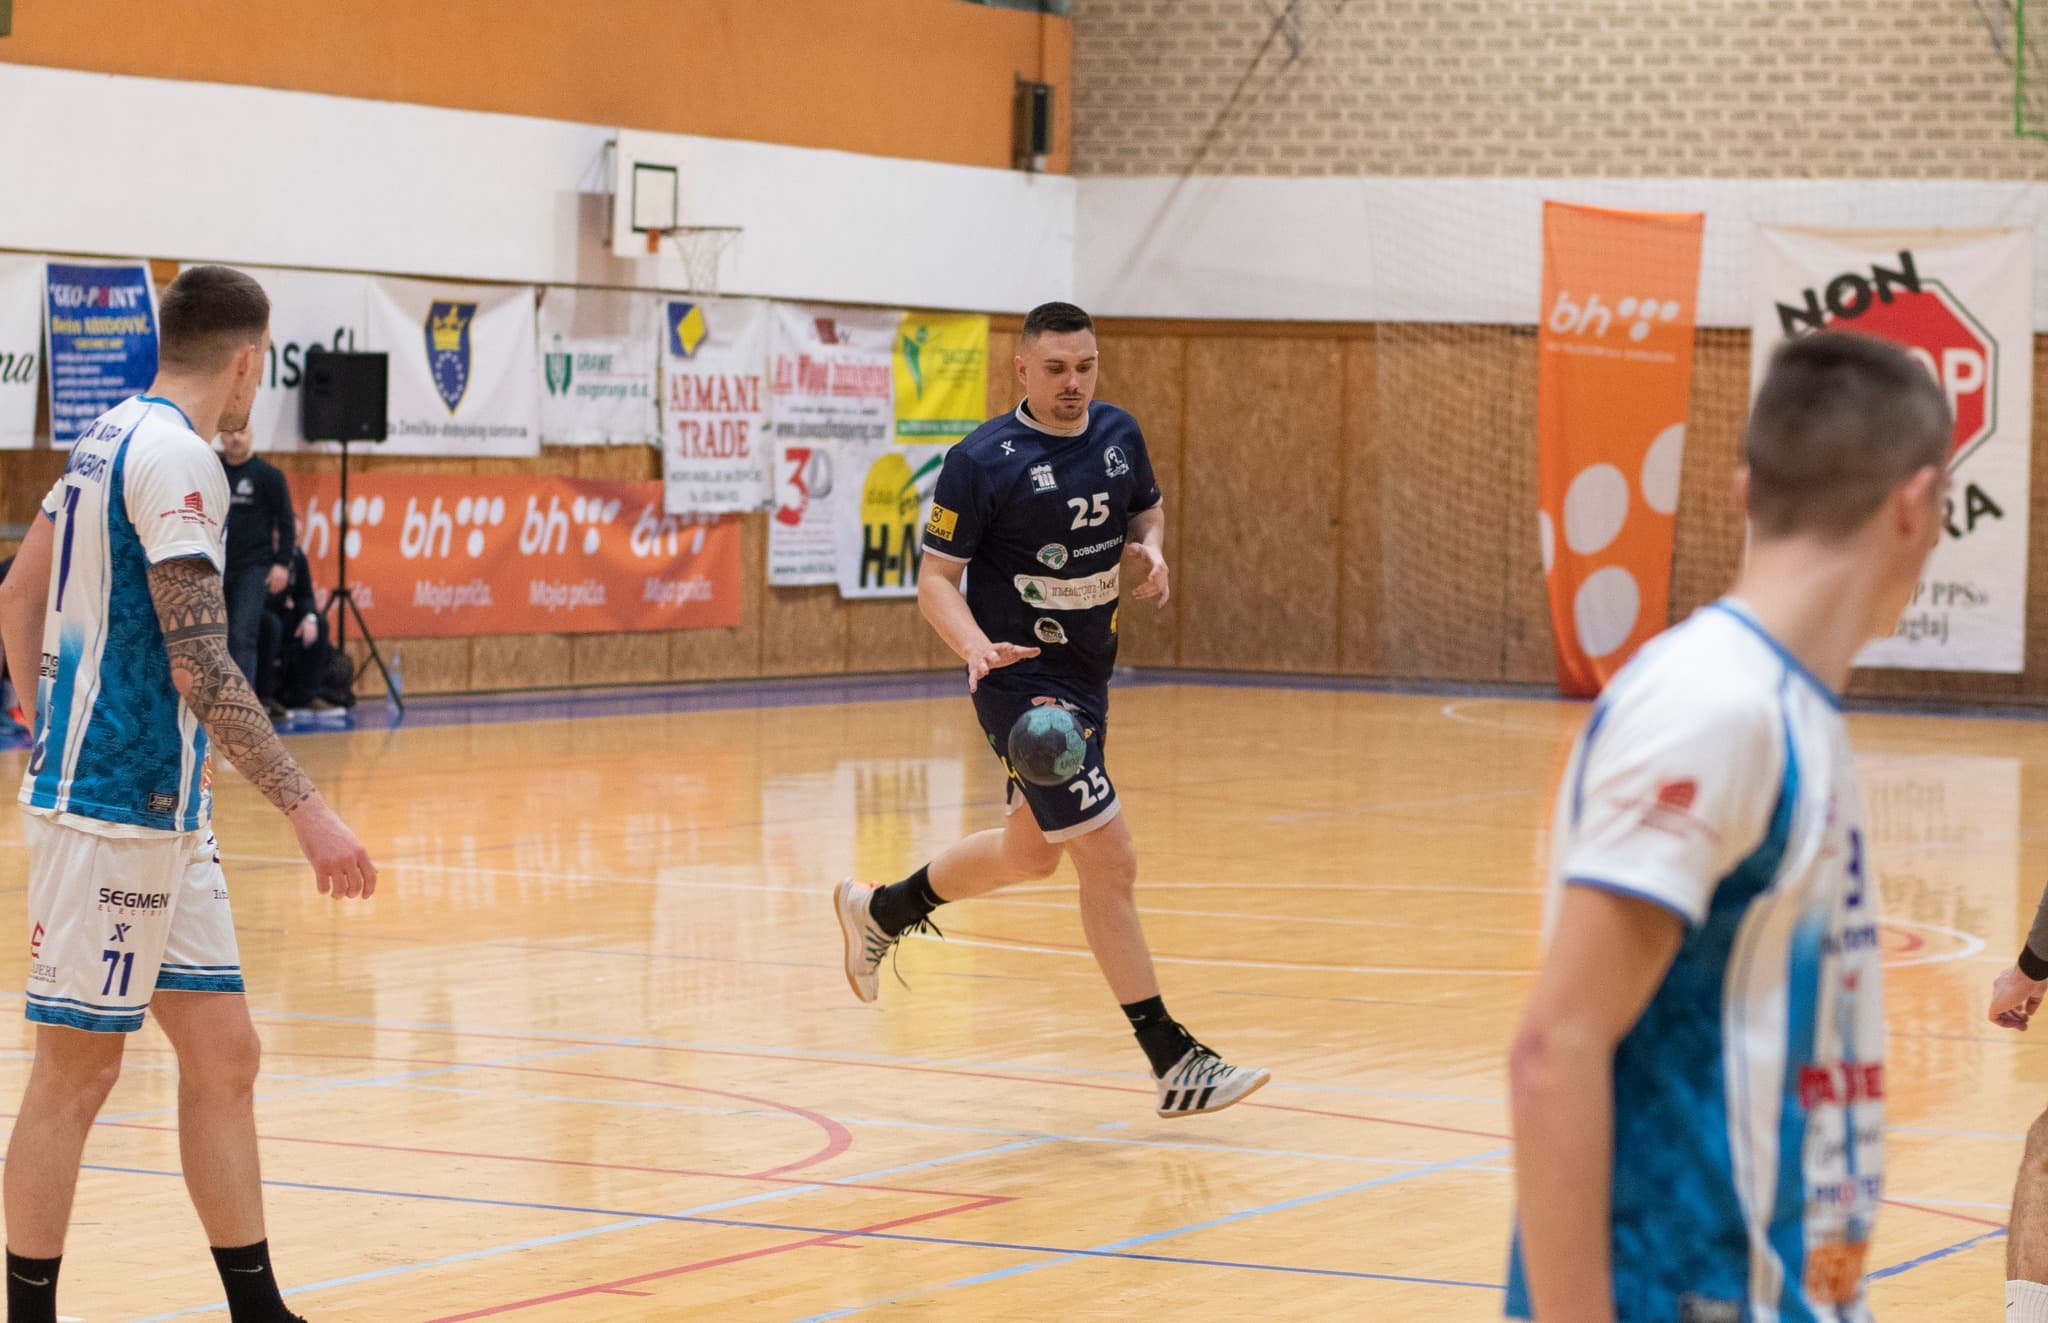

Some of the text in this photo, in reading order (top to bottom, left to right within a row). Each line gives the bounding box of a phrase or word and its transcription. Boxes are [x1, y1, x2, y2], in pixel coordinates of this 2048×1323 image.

[1549, 290, 1612, 336] bh
[1776, 249, 1921, 340] NON
[671, 374, 761, 413] ARMANI
[678, 420, 751, 460] TRADE
[401, 496, 452, 559] bh
[519, 495, 568, 556] bh
[1067, 491, 1110, 531] 25
[1068, 766, 1110, 811] 25
[101, 949, 136, 997] 71
